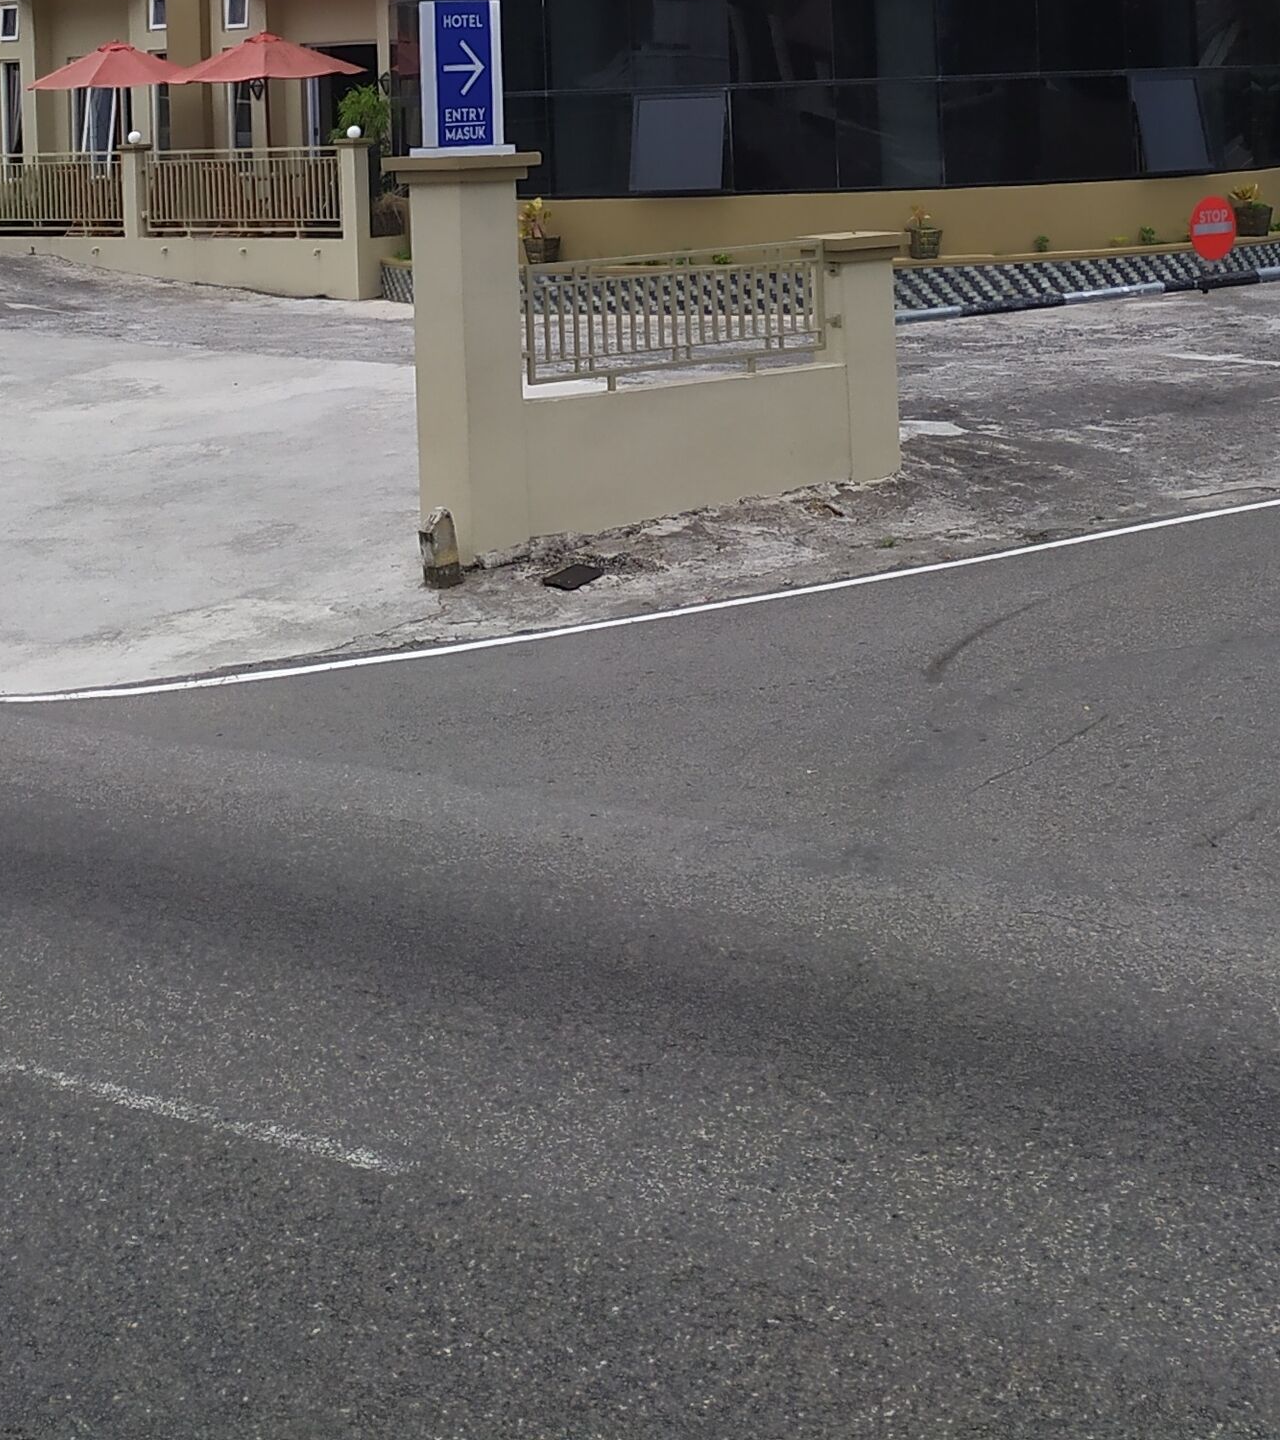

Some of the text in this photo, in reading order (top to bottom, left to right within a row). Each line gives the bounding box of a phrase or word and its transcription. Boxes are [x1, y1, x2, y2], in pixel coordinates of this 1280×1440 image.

[443, 14, 483, 29] HOTEL
[444, 107, 486, 122] ENTRY
[445, 125, 486, 141] MASUK
[1199, 209, 1229, 224] STOP
